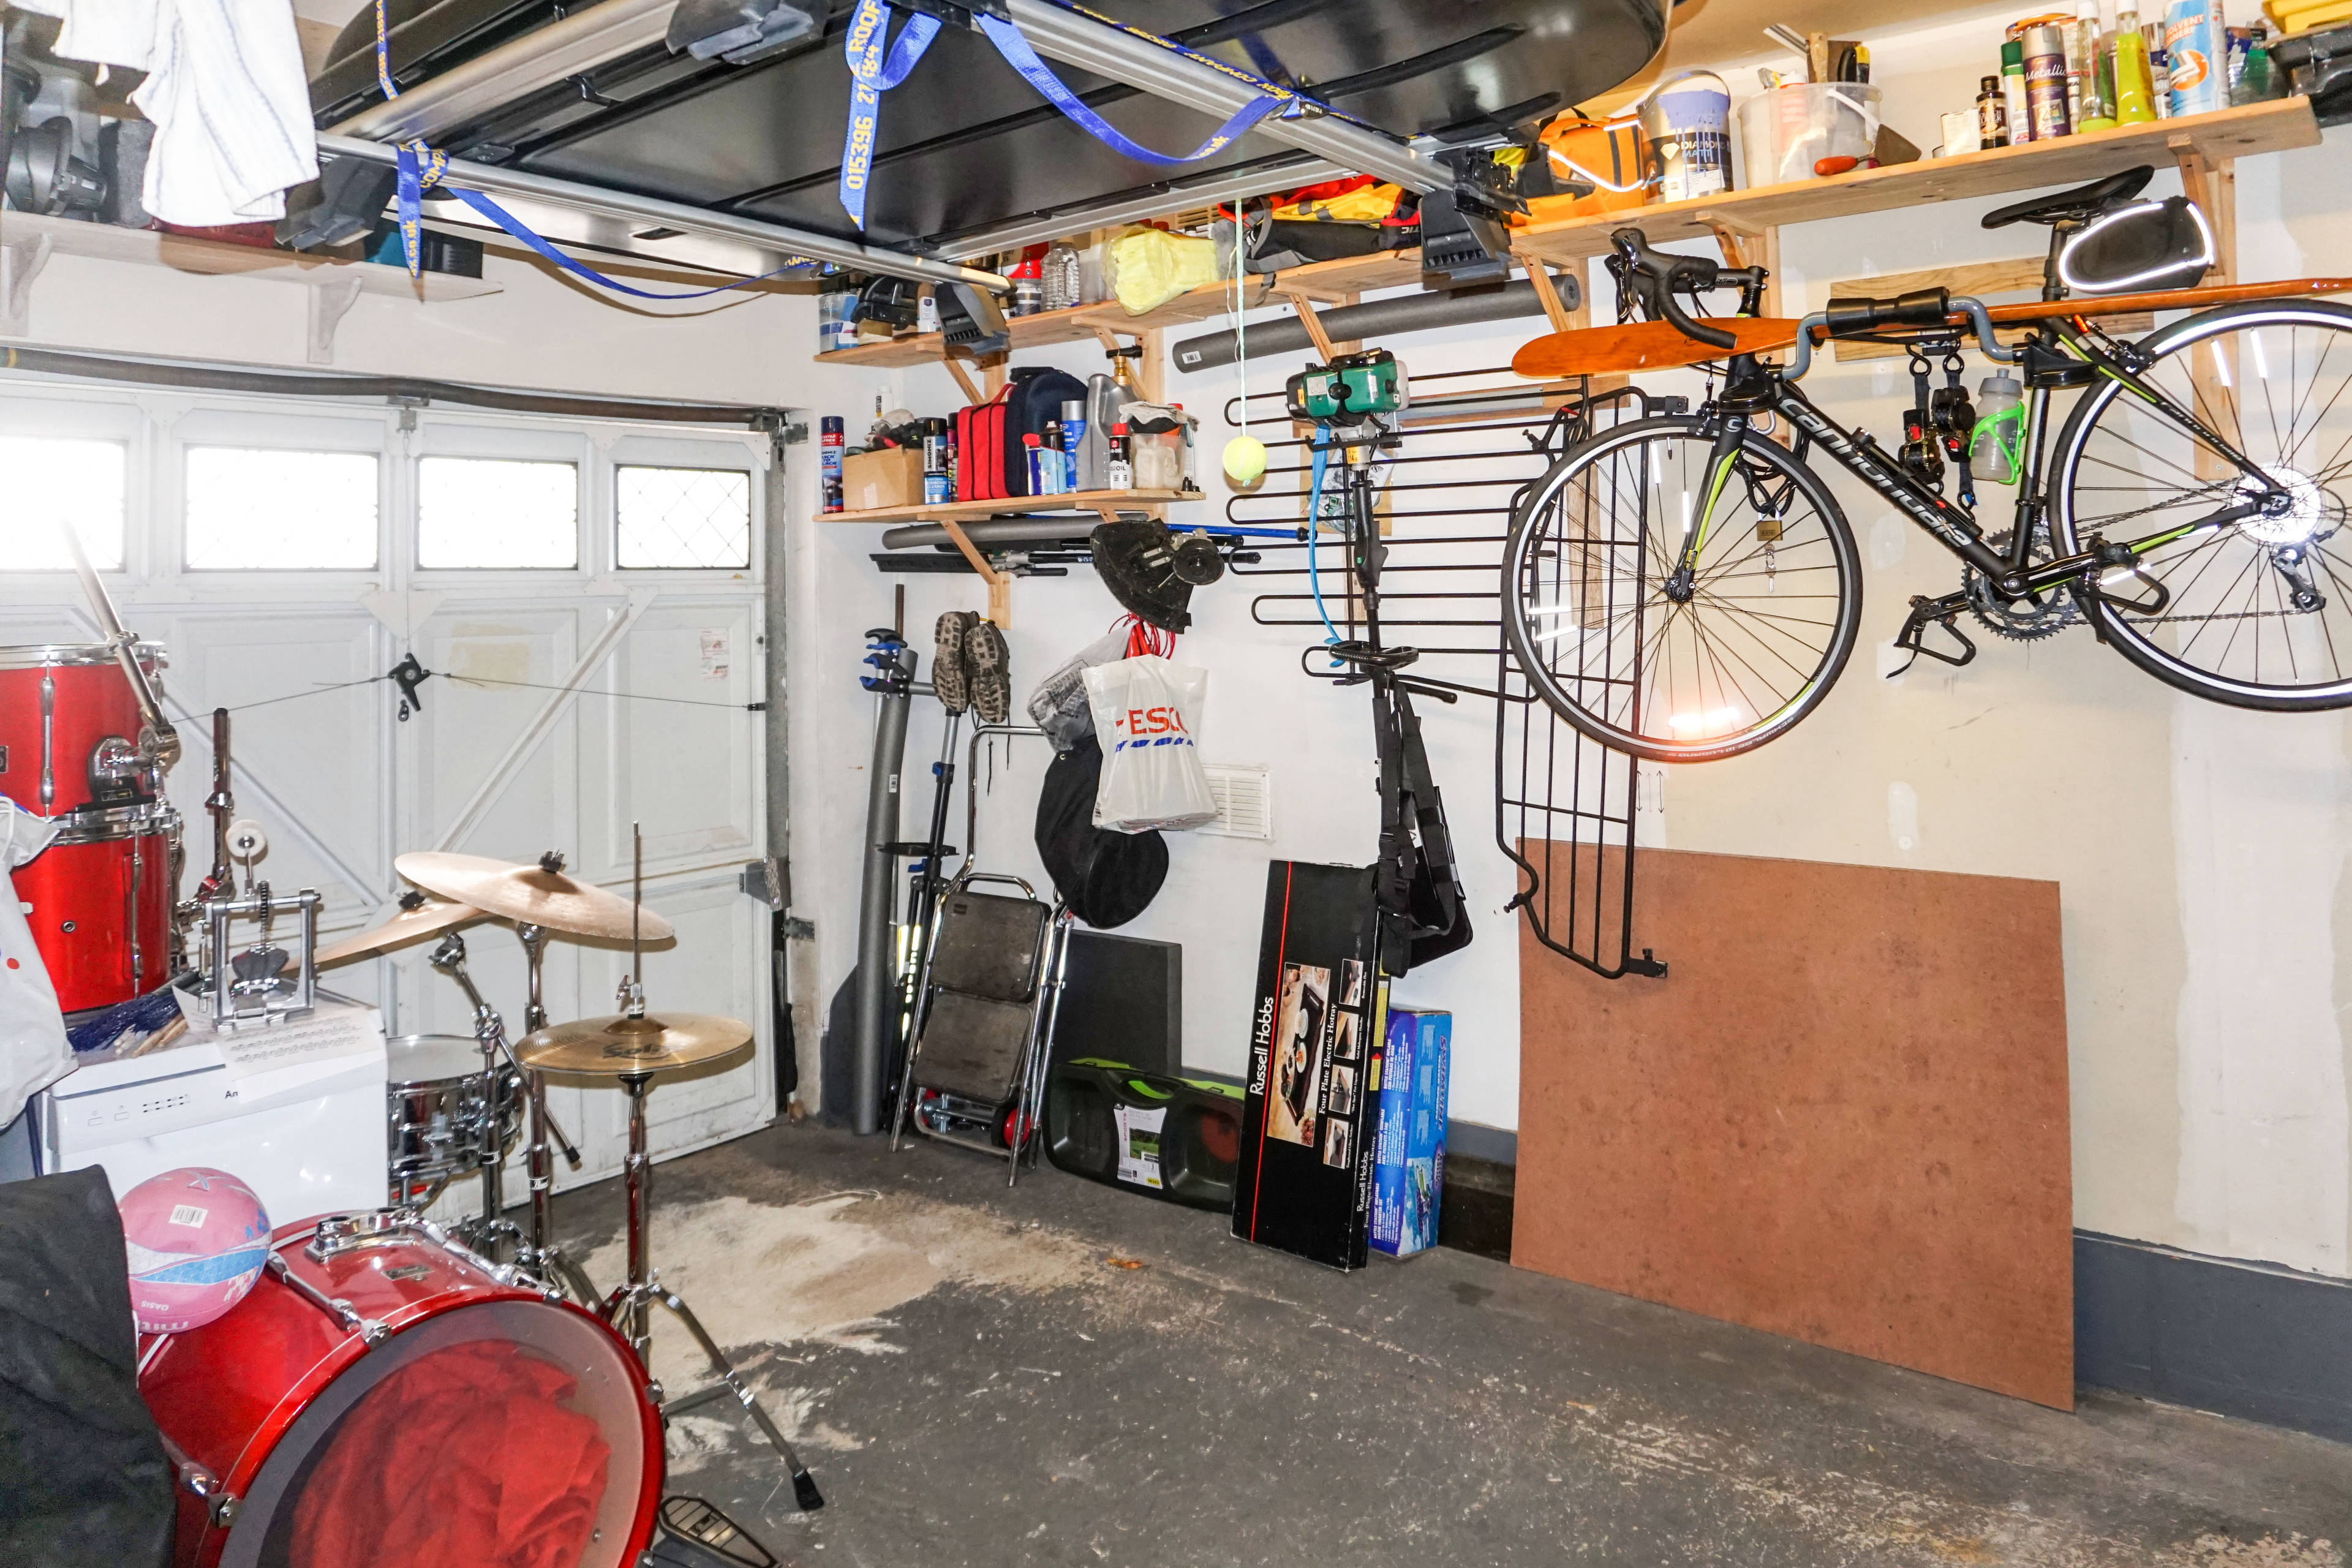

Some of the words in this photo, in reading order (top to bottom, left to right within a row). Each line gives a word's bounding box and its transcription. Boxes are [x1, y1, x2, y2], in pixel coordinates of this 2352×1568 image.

[846, 116, 873, 190] 015396
[1254, 995, 1274, 1044] Hobbs
[1326, 1002, 1338, 1034] Hotray
[1322, 1035, 1333, 1068] Electric
[1249, 1047, 1268, 1095] Russell
[1320, 1069, 1330, 1091] Plate
[1318, 1093, 1328, 1114] Four
[1359, 1150, 1368, 1181] Hobbs
[1356, 1182, 1366, 1212] Russell
[141, 1300, 169, 1312] OASIS
